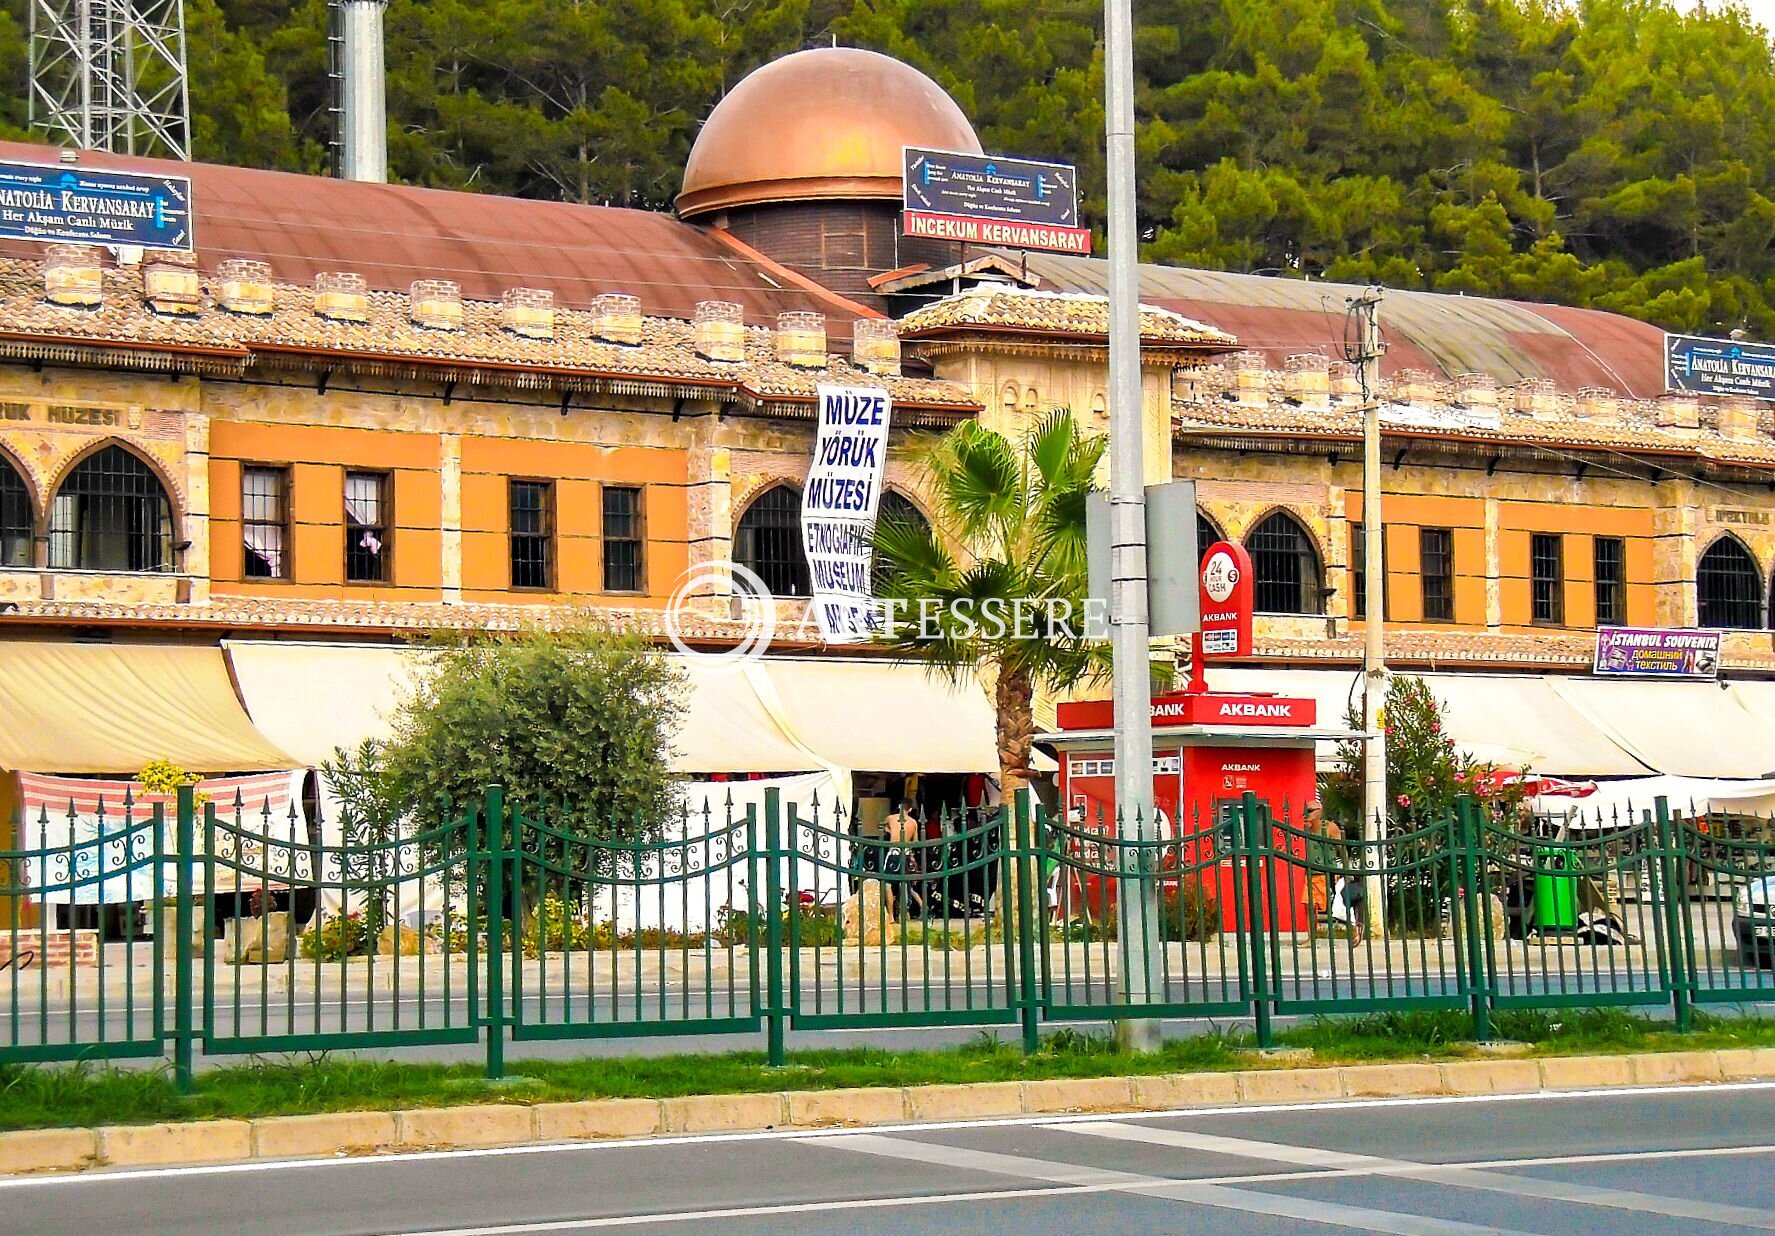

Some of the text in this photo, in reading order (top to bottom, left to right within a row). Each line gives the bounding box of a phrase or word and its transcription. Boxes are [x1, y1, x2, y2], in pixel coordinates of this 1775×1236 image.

[61, 190, 155, 219] KERVANSARAY
[2, 209, 25, 221] Her
[27, 211, 65, 226] Akşam
[99, 217, 135, 231] Müzik
[911, 213, 1085, 250] İNCEKUM KERVANSARAY
[825, 390, 885, 425] MÜZE
[818, 430, 879, 468] YÖRÜK
[807, 471, 873, 511] MÜZESİ
[812, 559, 866, 594] MUSEUM
[1210, 560, 1222, 576] 24
[1208, 583, 1227, 593] CASH
[1202, 612, 1237, 622] AKBANK
[1663, 635, 1718, 649] SOUVENIR
[1635, 660, 1678, 670] текстиль
[1219, 703, 1291, 717] AKBANK
[1221, 763, 1261, 771] AKBANK
